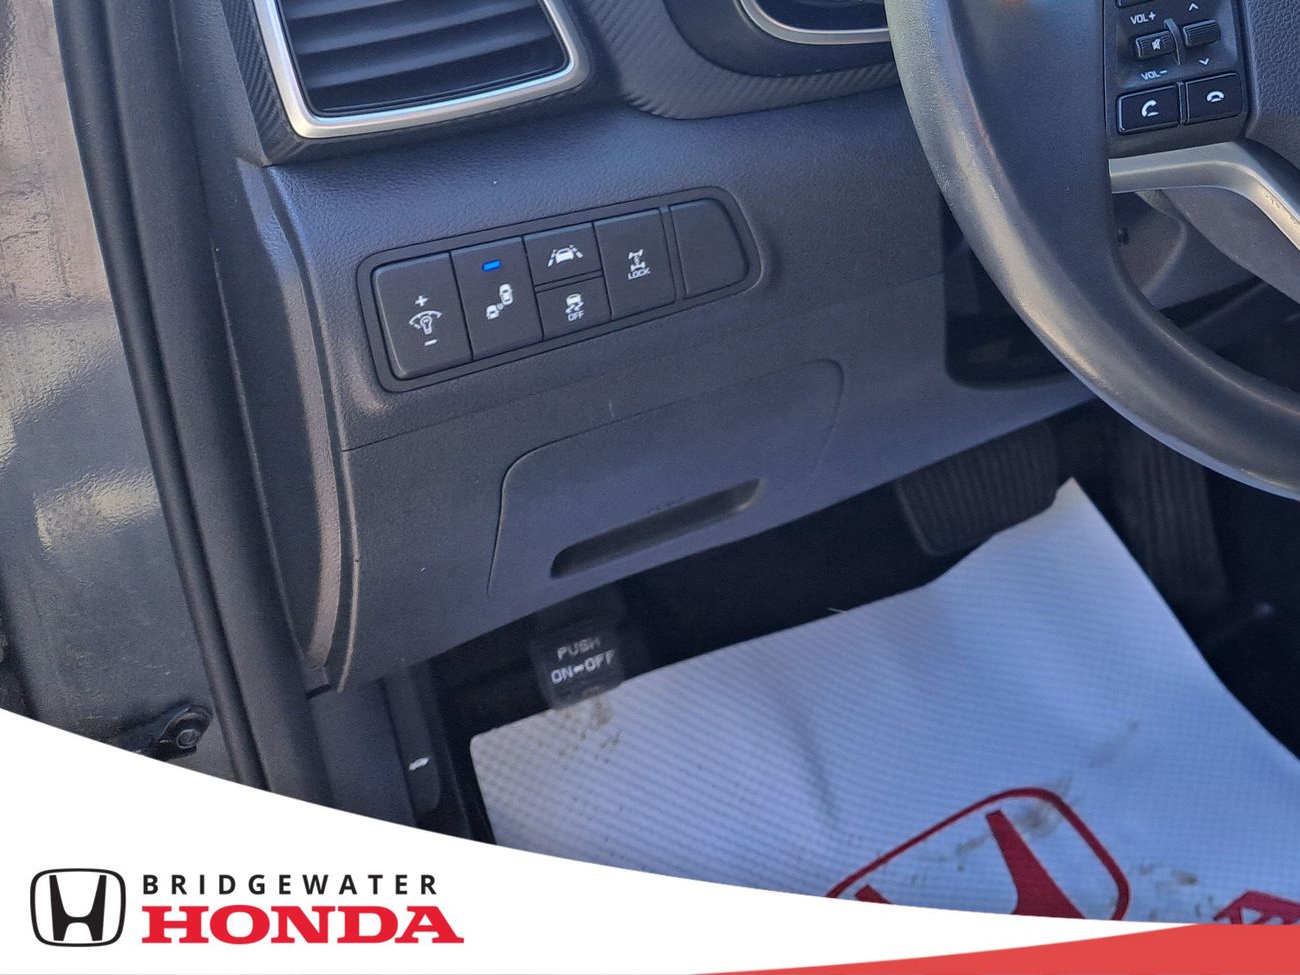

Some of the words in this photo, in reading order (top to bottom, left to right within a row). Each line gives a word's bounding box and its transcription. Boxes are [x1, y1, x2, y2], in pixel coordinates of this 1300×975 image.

[627, 267, 651, 280] LOCK
[567, 309, 585, 322] OFF
[557, 637, 601, 660] PUSH
